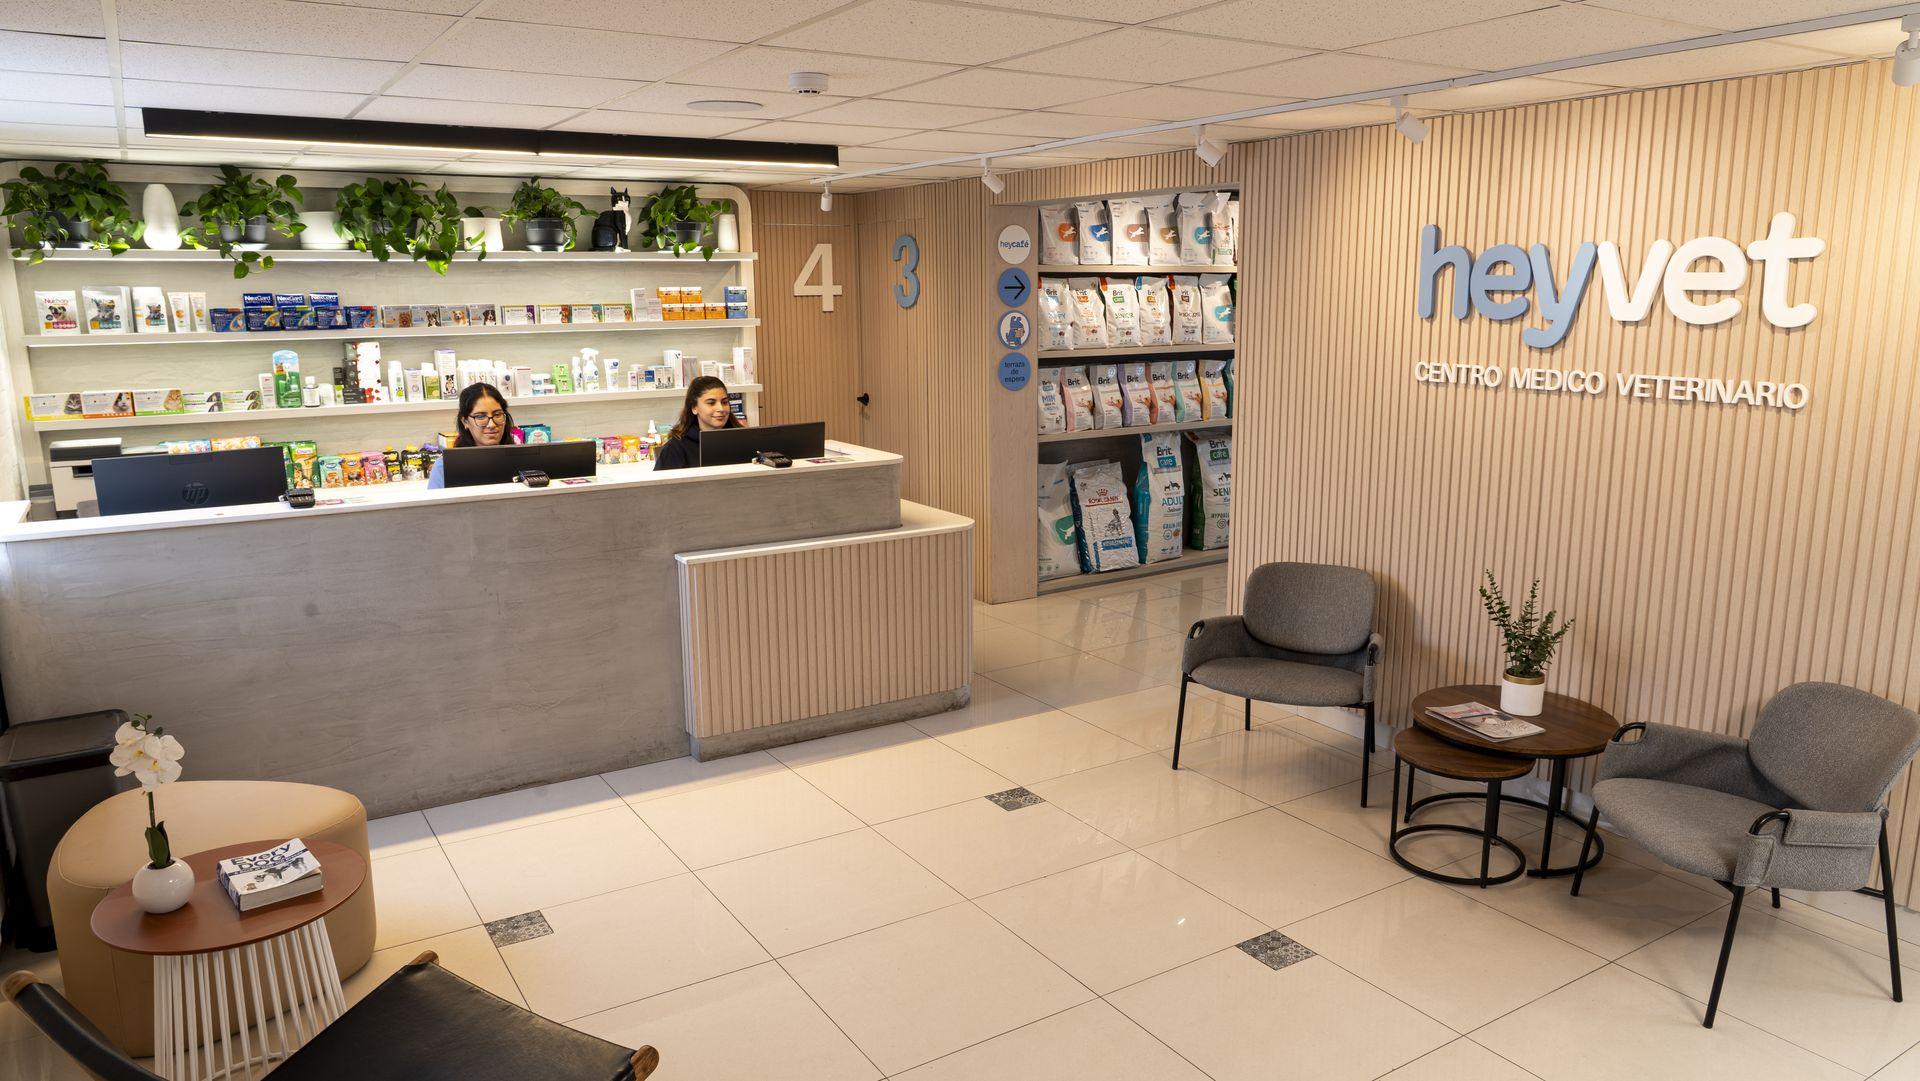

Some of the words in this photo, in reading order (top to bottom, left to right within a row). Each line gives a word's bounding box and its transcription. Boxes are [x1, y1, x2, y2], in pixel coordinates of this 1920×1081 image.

[1000, 239, 1029, 249] heycafé
[893, 235, 920, 308] 3
[794, 244, 843, 312] 4
[1418, 212, 1826, 349] heyvet
[1004, 376, 1025, 384] espera
[1098, 376, 1111, 385] Brit
[1127, 375, 1139, 383] Brit
[1152, 373, 1165, 381] Brit
[1177, 372, 1190, 380] Brit
[1067, 378, 1080, 386] Brit
[1415, 361, 1503, 388] CENTRO
[1509, 367, 1606, 395] MEDICO
[1616, 372, 1810, 410] VETERINARIO
[1208, 439, 1227, 449] Brit
[1156, 446, 1173, 456] Brit
[1212, 451, 1228, 459] care
[1162, 495, 1184, 506] ADULT
[230, 843, 291, 866] Every
